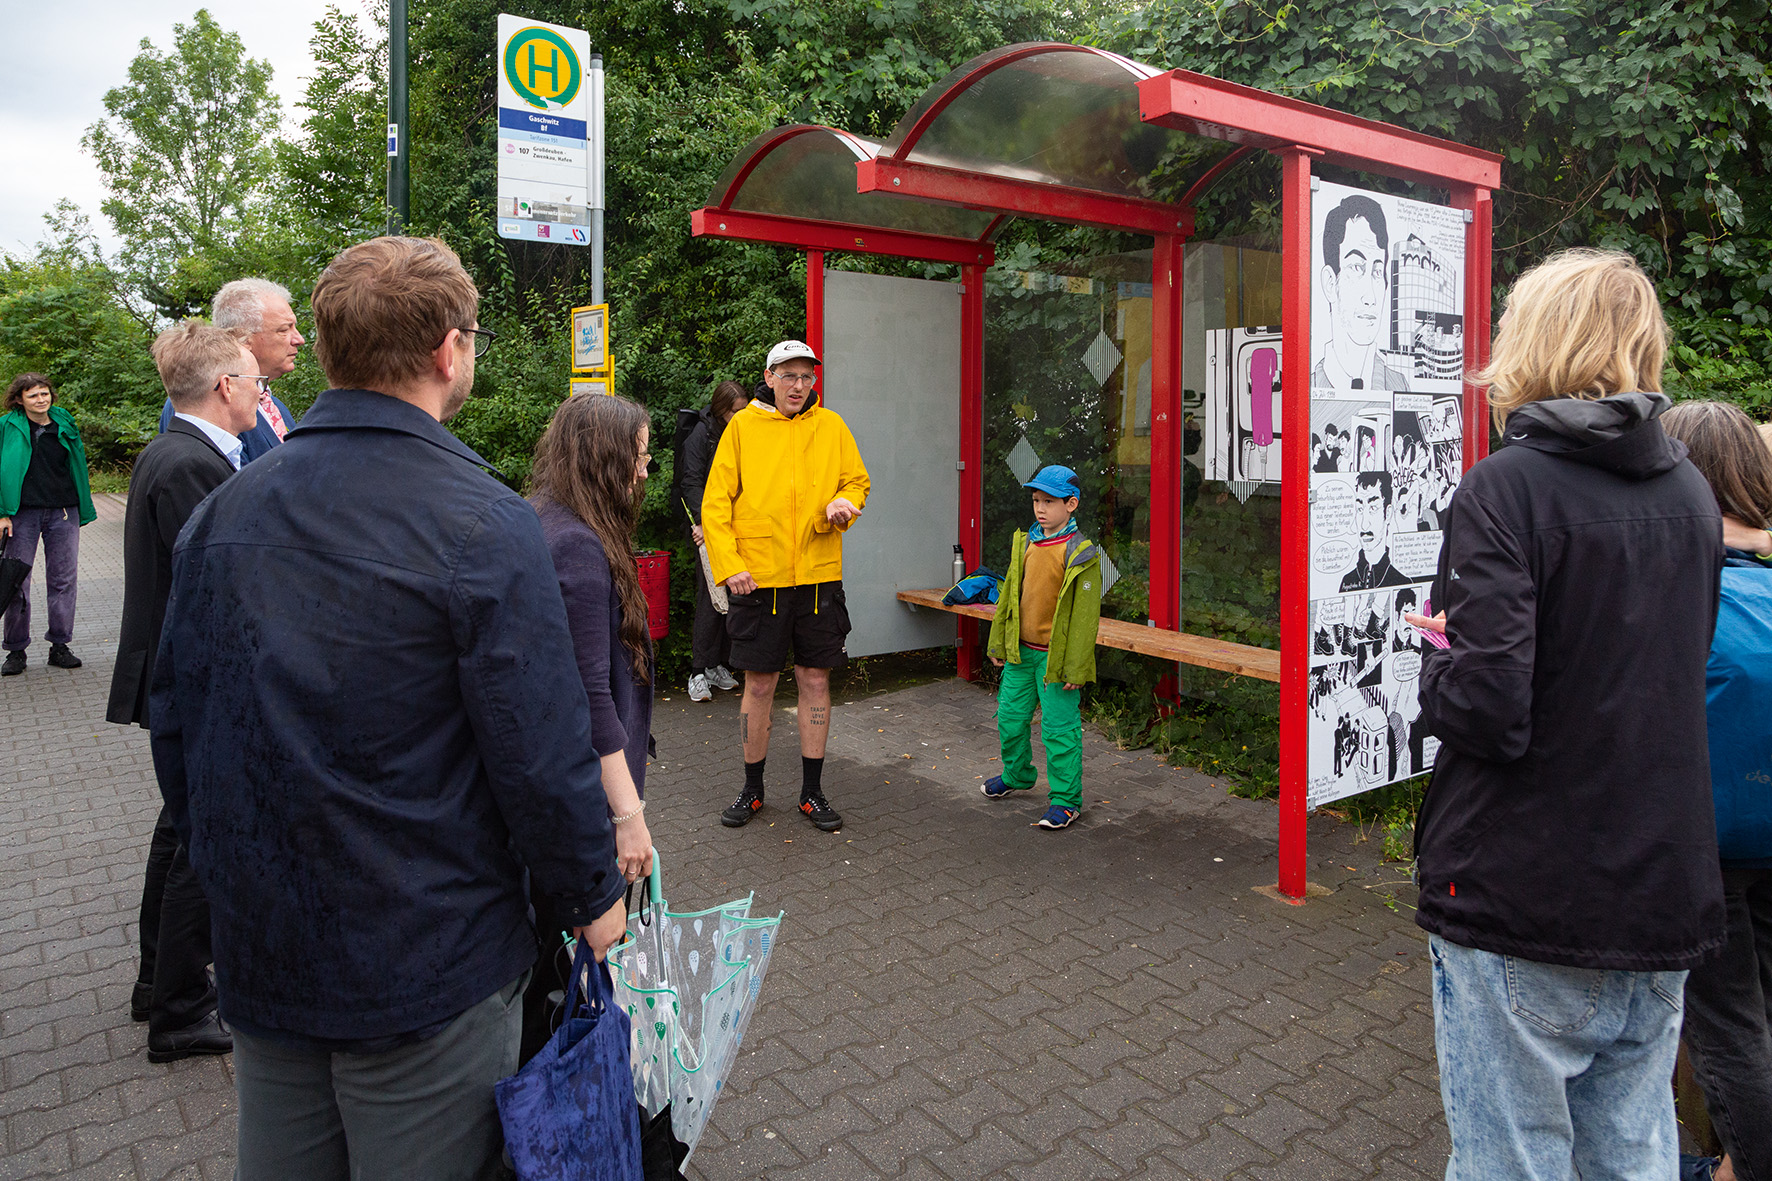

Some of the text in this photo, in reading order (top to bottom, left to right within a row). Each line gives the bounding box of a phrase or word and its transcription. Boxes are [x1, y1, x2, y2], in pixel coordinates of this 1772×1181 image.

[528, 44, 558, 92] H
[528, 114, 560, 126] Gaschwitz
[529, 134, 550, 142] Tarifzone
[533, 146, 563, 155] Großdeuben
[532, 153, 556, 161] Zwenkau,
[1401, 250, 1440, 272] mdr
